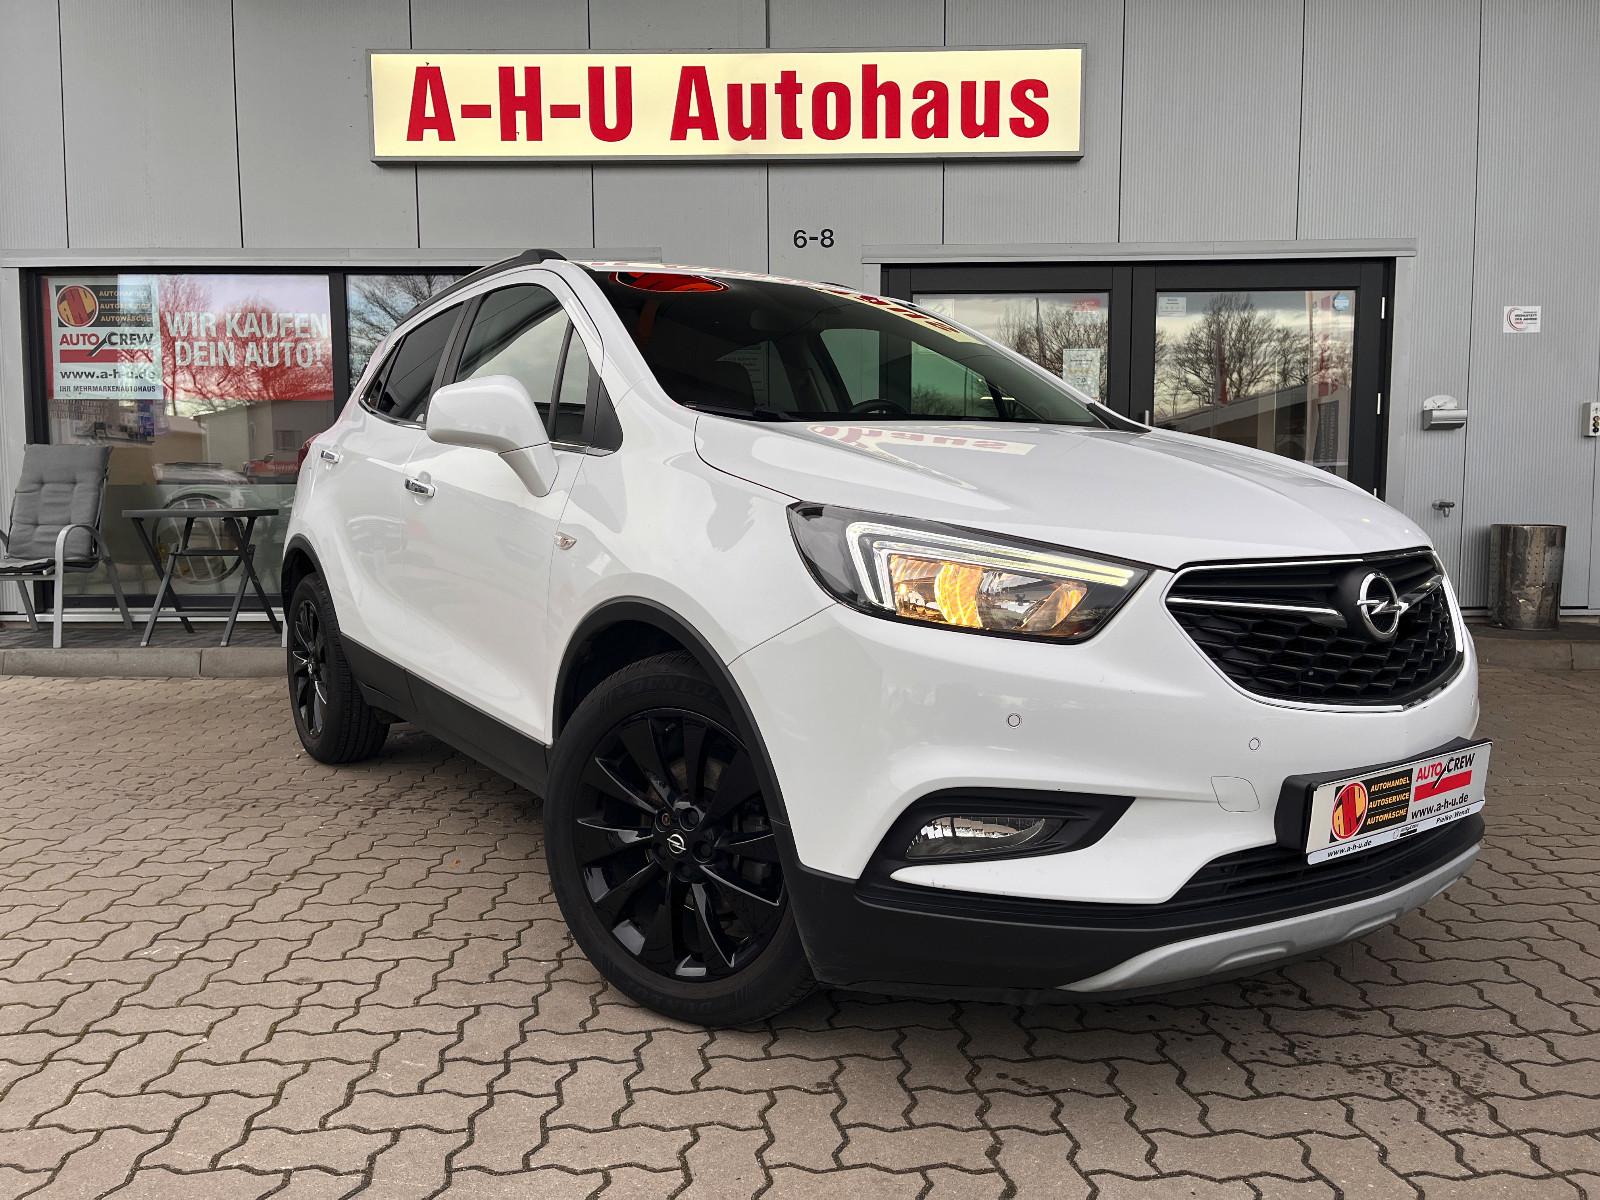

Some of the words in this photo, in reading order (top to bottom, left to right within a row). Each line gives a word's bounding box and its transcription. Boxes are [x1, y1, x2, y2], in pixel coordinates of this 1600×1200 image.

[406, 65, 633, 143] A-H-U
[670, 63, 1050, 142] Autohaus
[793, 228, 835, 249] 6-8
[165, 311, 217, 338] WIR
[225, 311, 329, 338] KAUFEN
[59, 333, 100, 346] AUTO
[107, 332, 154, 346] CREW
[174, 341, 237, 367] DEIN
[244, 341, 324, 368] AUTO!
[59, 368, 157, 380] www.a-h-u.de
[59, 385, 71, 393] IHR
[73, 385, 156, 393] MEHRMARKENAUTOHAUS
[1415, 762, 1442, 782] AUTO
[1446, 753, 1476, 772] CREW
[1370, 776, 1410, 793] AUTOHANDEL
[1368, 792, 1410, 809] AUTOSERVICE
[1411, 792, 1469, 820] www.a-h-u.de
[1327, 840, 1372, 857] www.a-h-u.de
